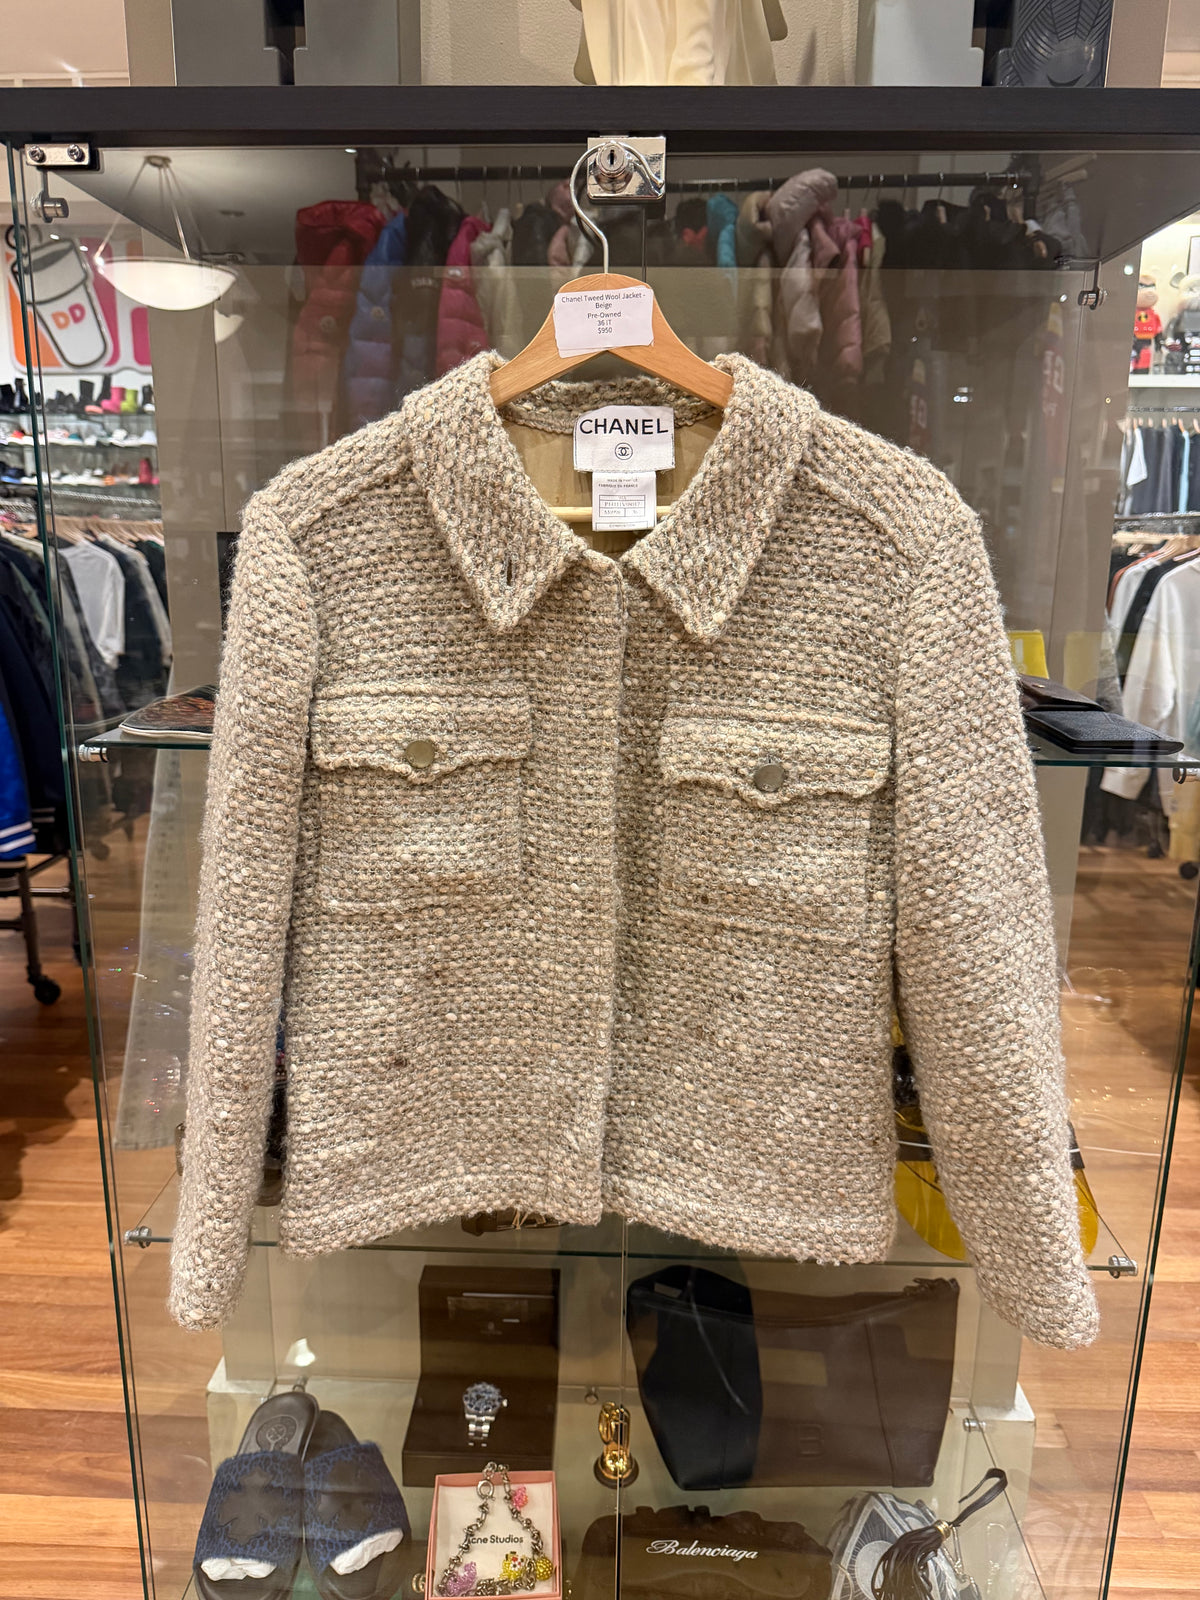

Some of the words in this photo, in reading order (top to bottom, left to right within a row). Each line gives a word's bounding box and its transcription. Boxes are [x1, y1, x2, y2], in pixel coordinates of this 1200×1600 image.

[561, 295, 583, 303] Chanel
[584, 294, 604, 302] Tweed
[605, 293, 621, 301] Wool
[622, 292, 642, 300] Jacket
[579, 418, 669, 435] CHANEL
[490, 1534, 524, 1544] Studios
[645, 1539, 759, 1561] Balenciaga
